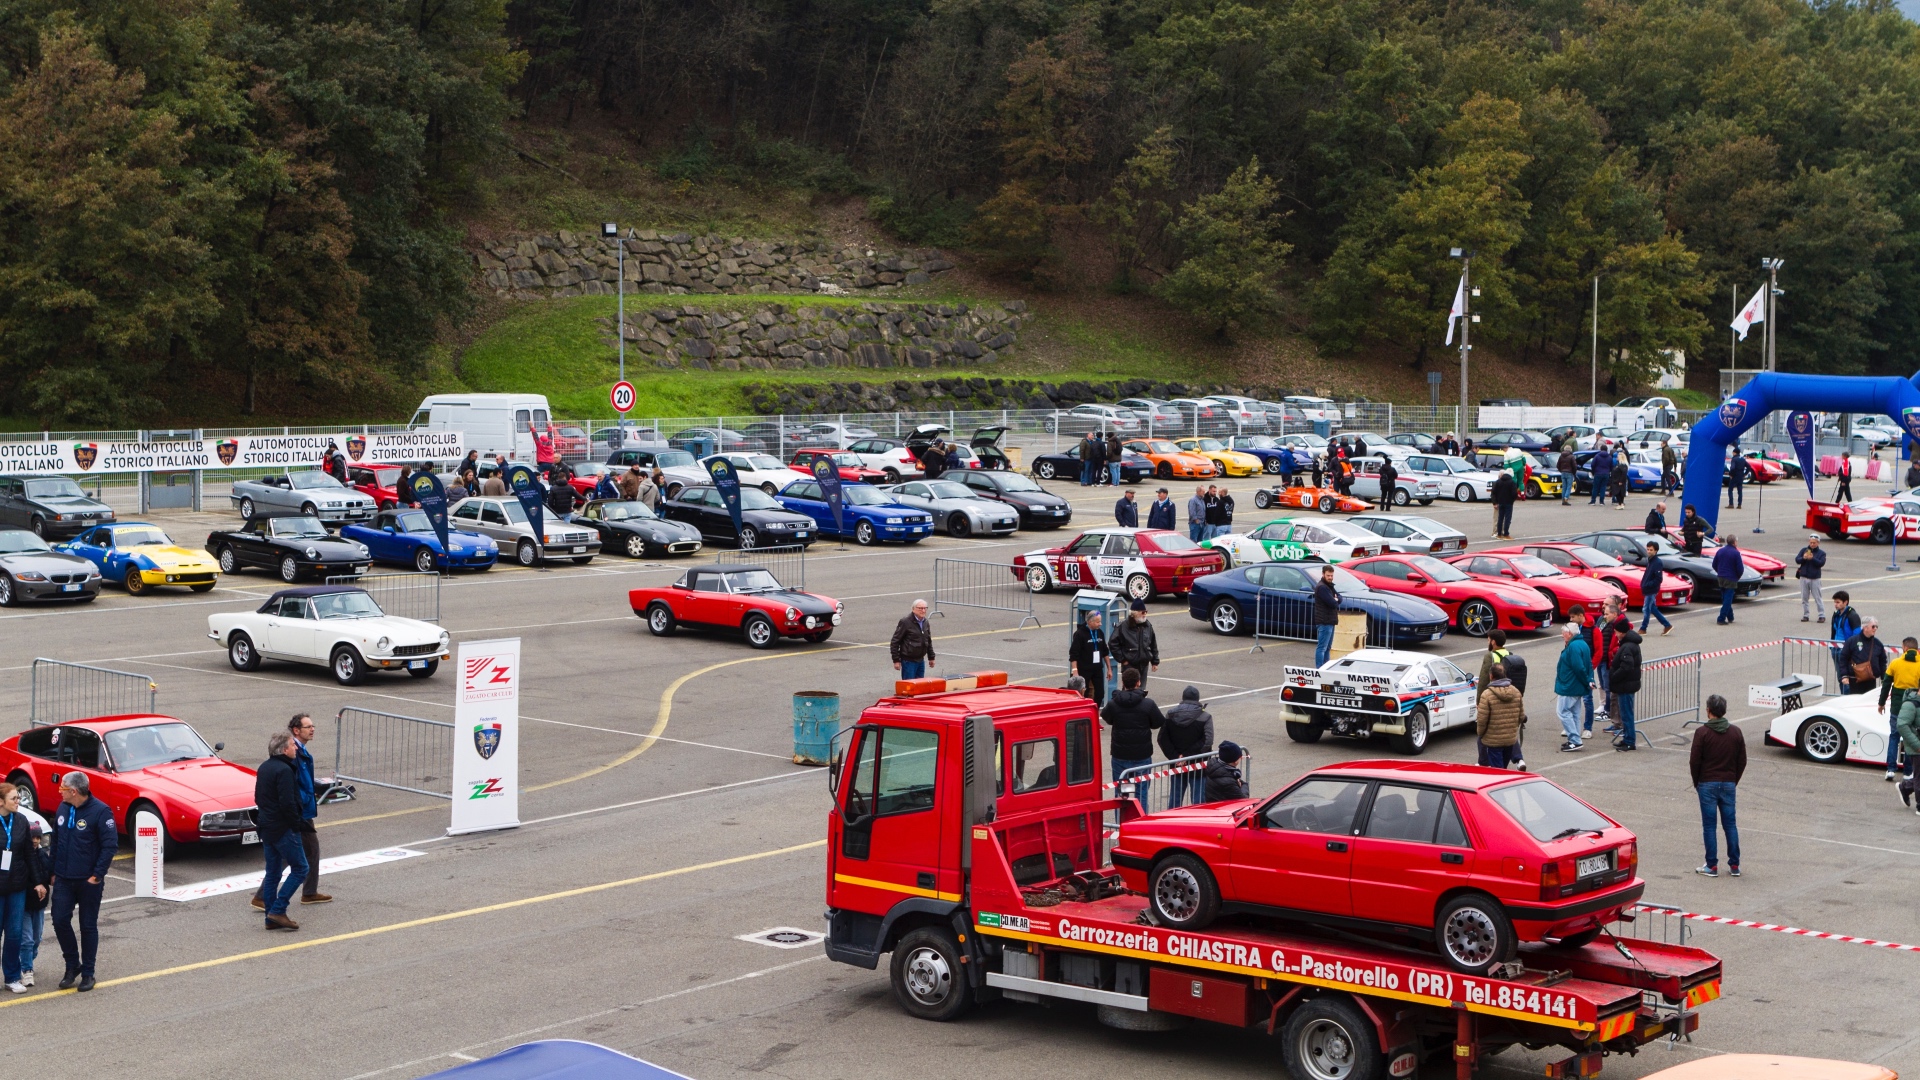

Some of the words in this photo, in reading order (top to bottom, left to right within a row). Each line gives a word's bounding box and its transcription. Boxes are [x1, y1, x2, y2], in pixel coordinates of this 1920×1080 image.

[616, 390, 630, 404] 20
[249, 437, 335, 450] AUTOMOTOCLUB
[376, 433, 457, 446] AUTOMOTOCLUB
[1, 444, 58, 457] OTOCLUB
[110, 441, 204, 455] AUTOMOTOCLUB
[372, 448, 414, 460] STORICO
[417, 446, 462, 458] ITALIANO
[104, 456, 154, 469] STORICO
[157, 454, 209, 467] ITALIANO
[244, 452, 289, 464] STORICO
[292, 450, 325, 462] ITALIA
[7, 458, 64, 471] ITALIANO
[1303, 495, 1312, 505] 114
[1270, 544, 1304, 560] totip
[1066, 563, 1080, 580] 48
[1285, 667, 1322, 678] LANCIA
[1348, 674, 1390, 684] MARTINI
[1290, 677, 1314, 685] MARTINI
[1363, 685, 1389, 693] MARTINI
[1316, 692, 1362, 708] PIRELLI
[1058, 918, 1159, 953] Carrozzeria
[1166, 934, 1262, 968] CHIASTRA
[1271, 950, 1399, 990] G.-Pastorello
[1408, 968, 1453, 1000] (PR)
[1462, 980, 1576, 1020] Tel.854141
